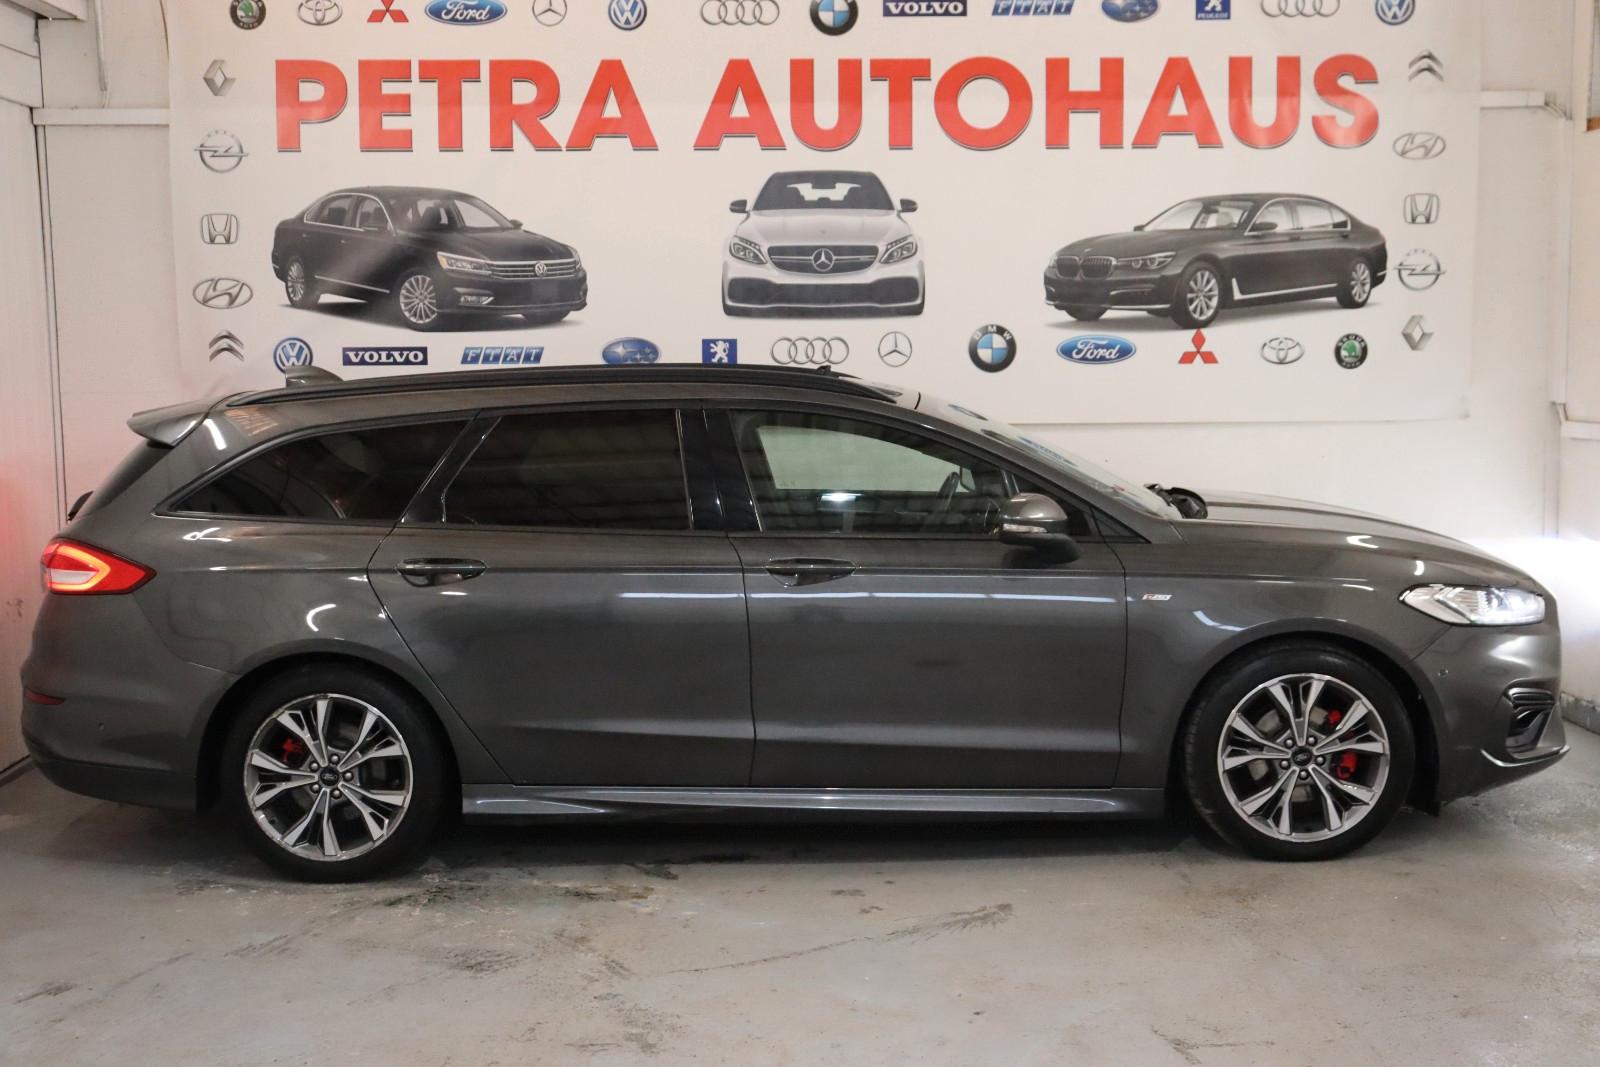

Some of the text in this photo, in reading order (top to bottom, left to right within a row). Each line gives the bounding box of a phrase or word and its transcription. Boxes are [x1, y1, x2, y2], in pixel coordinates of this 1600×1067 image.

[441, 0, 491, 20] Ford
[885, 1, 965, 15] VOLVO
[997, 0, 1071, 14] FIAT
[275, 53, 1379, 153] PETRA AUTOHAUS
[345, 350, 424, 363] VOLVO
[465, 348, 542, 362] FIAT
[1071, 339, 1121, 360] Ford
